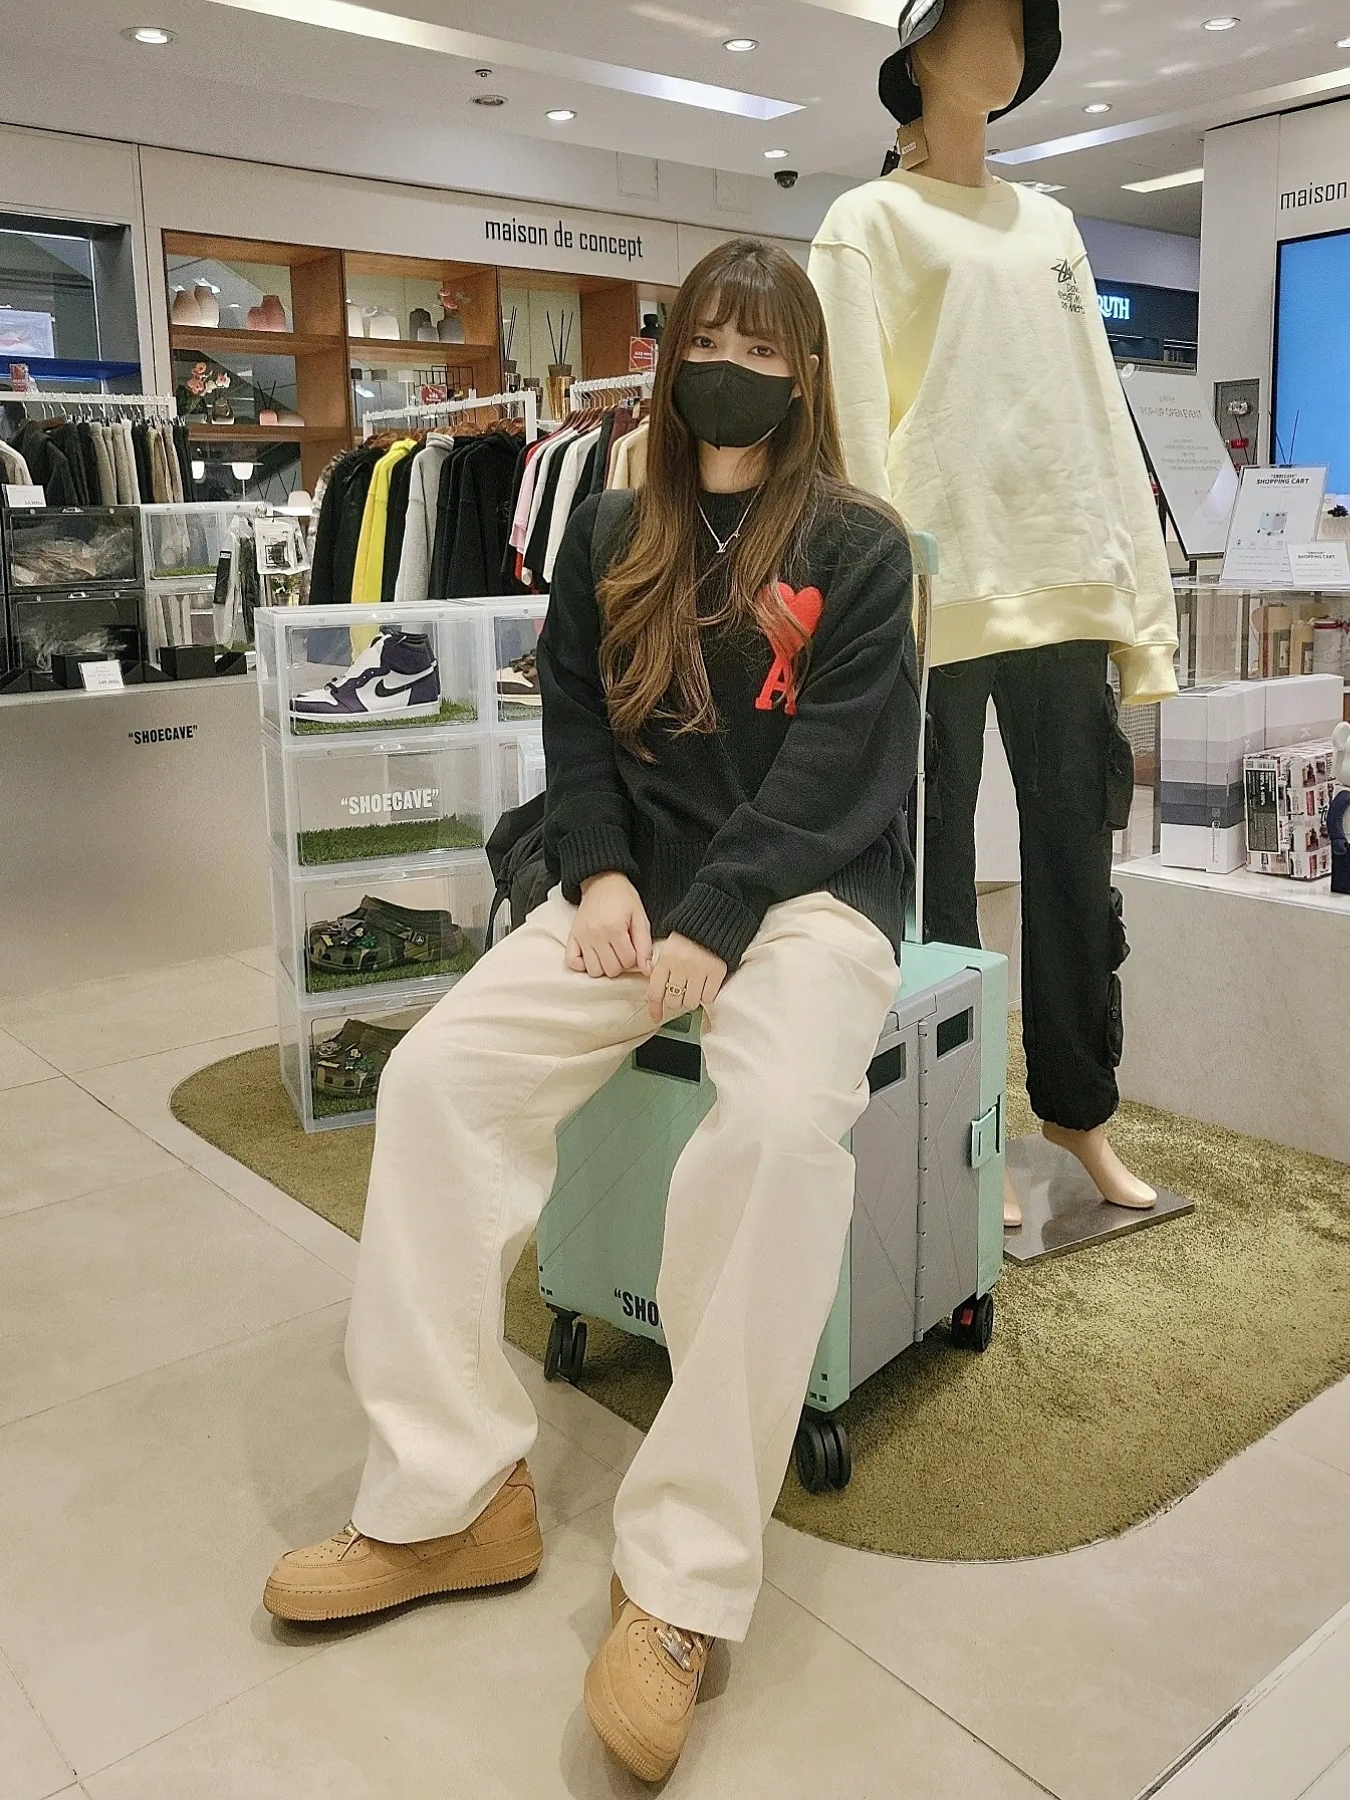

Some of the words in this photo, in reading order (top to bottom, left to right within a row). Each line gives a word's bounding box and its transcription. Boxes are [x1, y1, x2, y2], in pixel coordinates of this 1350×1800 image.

[1280, 182, 1347, 210] maison
[485, 218, 548, 246] maison
[554, 220, 573, 248] de
[579, 233, 644, 262] concept
